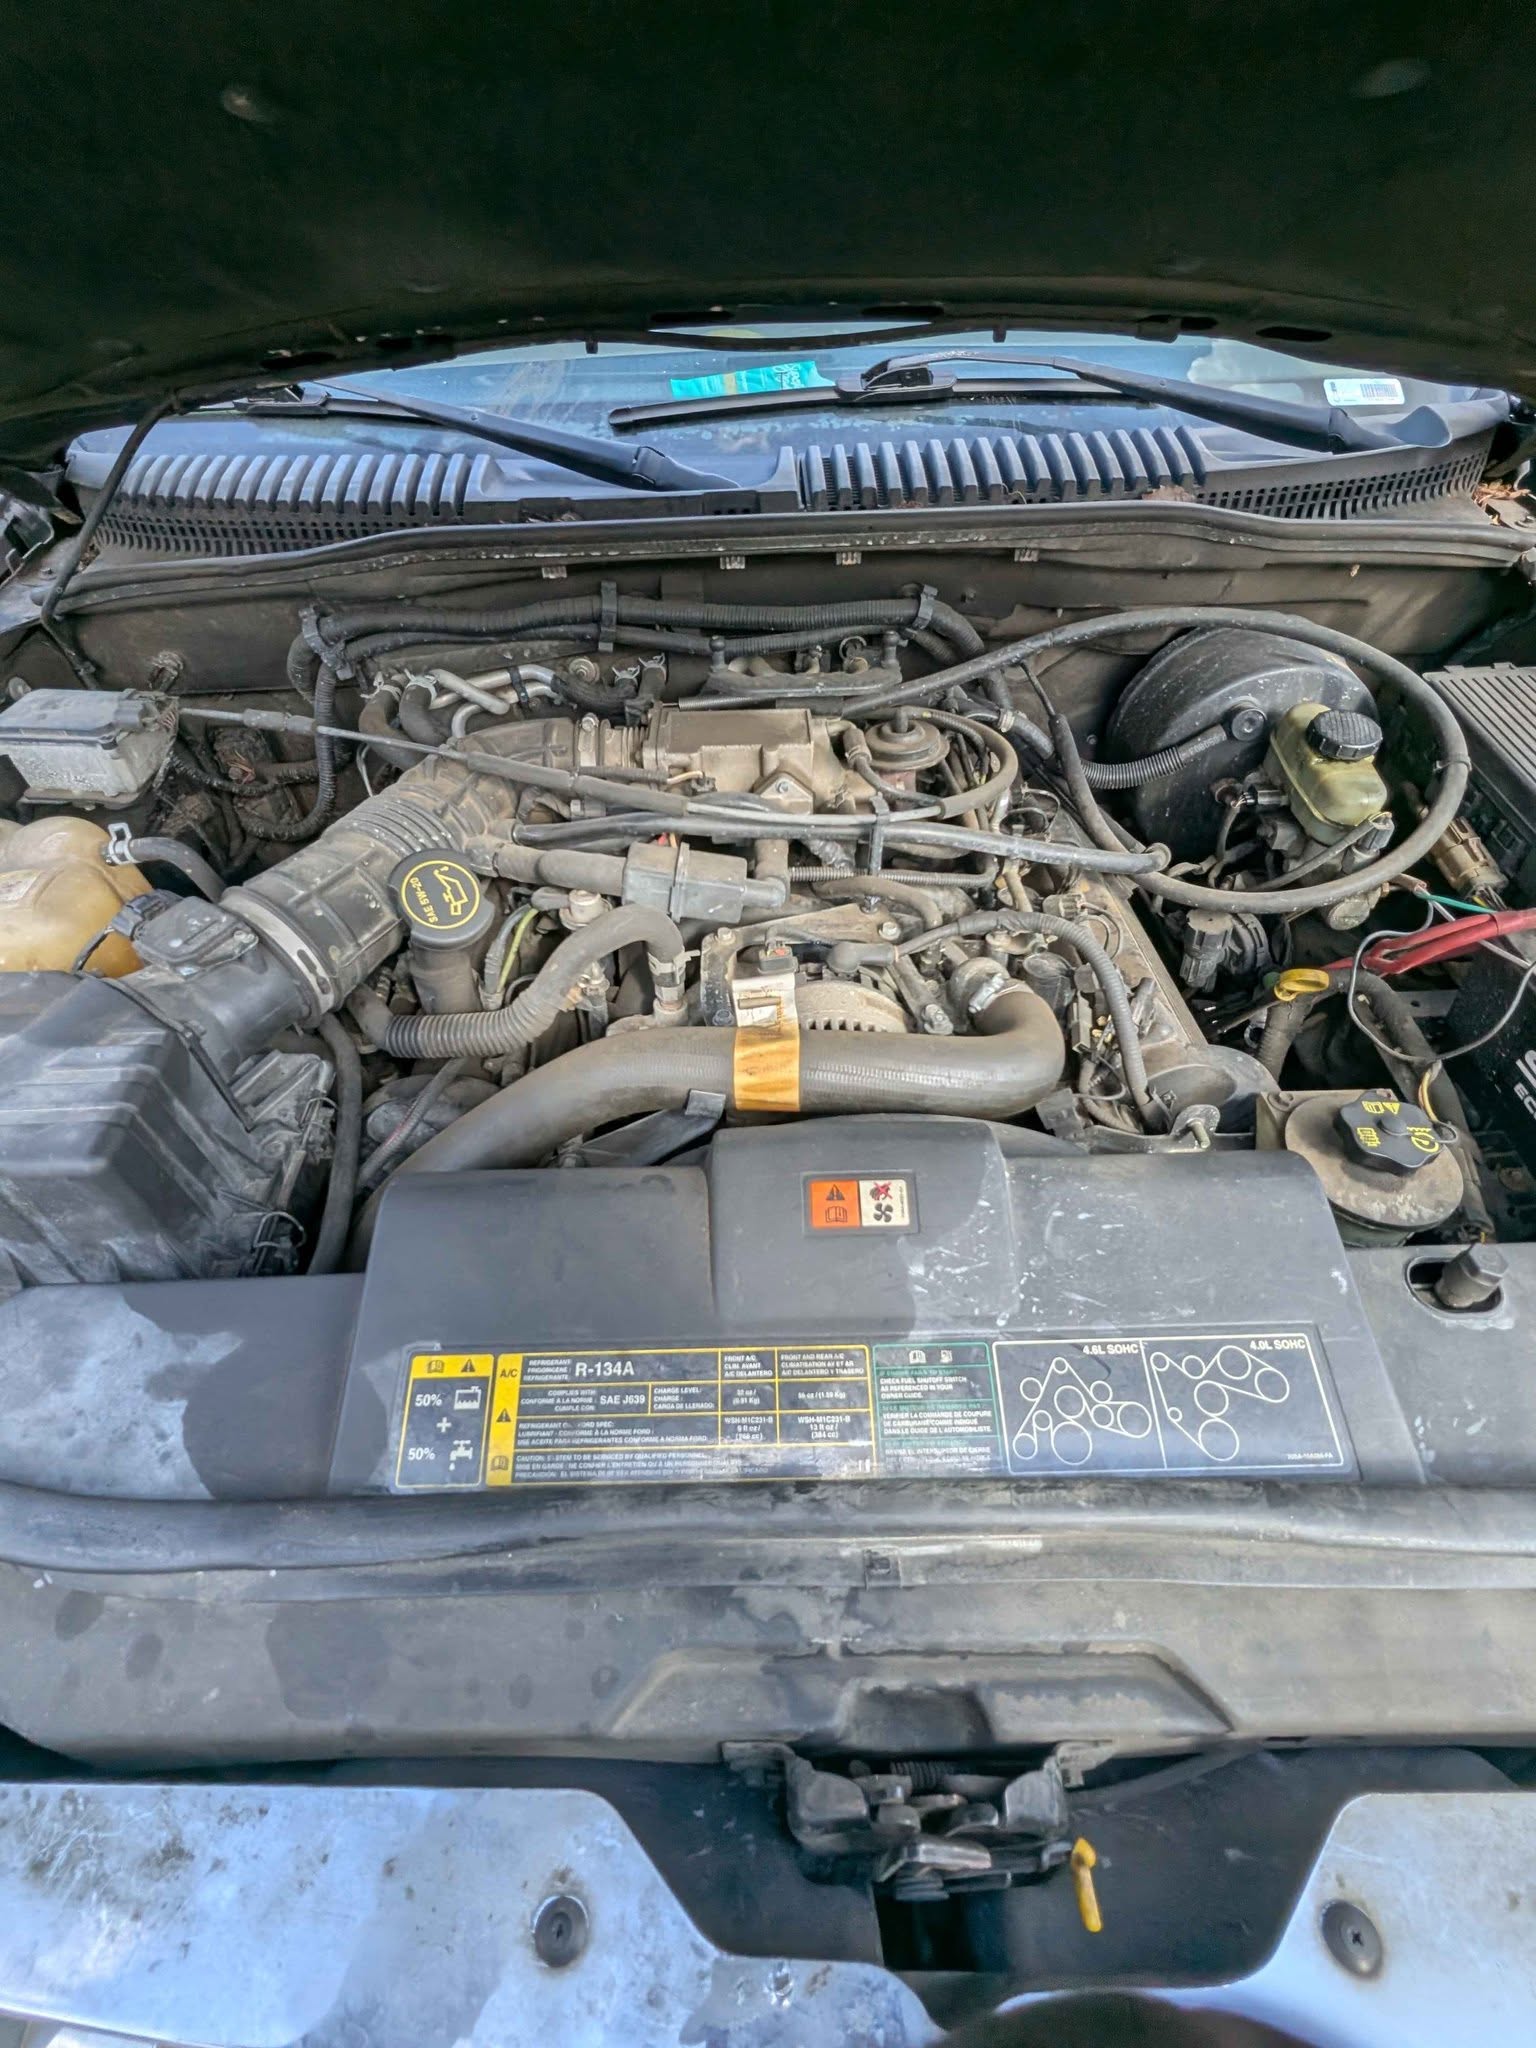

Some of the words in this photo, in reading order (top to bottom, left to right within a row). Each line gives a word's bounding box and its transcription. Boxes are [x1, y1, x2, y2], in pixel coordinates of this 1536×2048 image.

[410, 877, 430, 905] 5W-20
[424, 905, 438, 922] SAE
[1082, 1344, 1106, 1355] 4.6L
[1106, 1344, 1139, 1354] SOHC
[1250, 1340, 1273, 1350] 4.0L
[1274, 1339, 1306, 1350] SOHC
[500, 1368, 518, 1378] A/C
[575, 1361, 635, 1377] R-134A
[415, 1394, 442, 1407] 50%
[600, 1395, 620, 1405] SAE
[622, 1394, 646, 1404] J639
[408, 1447, 436, 1460] 50%
